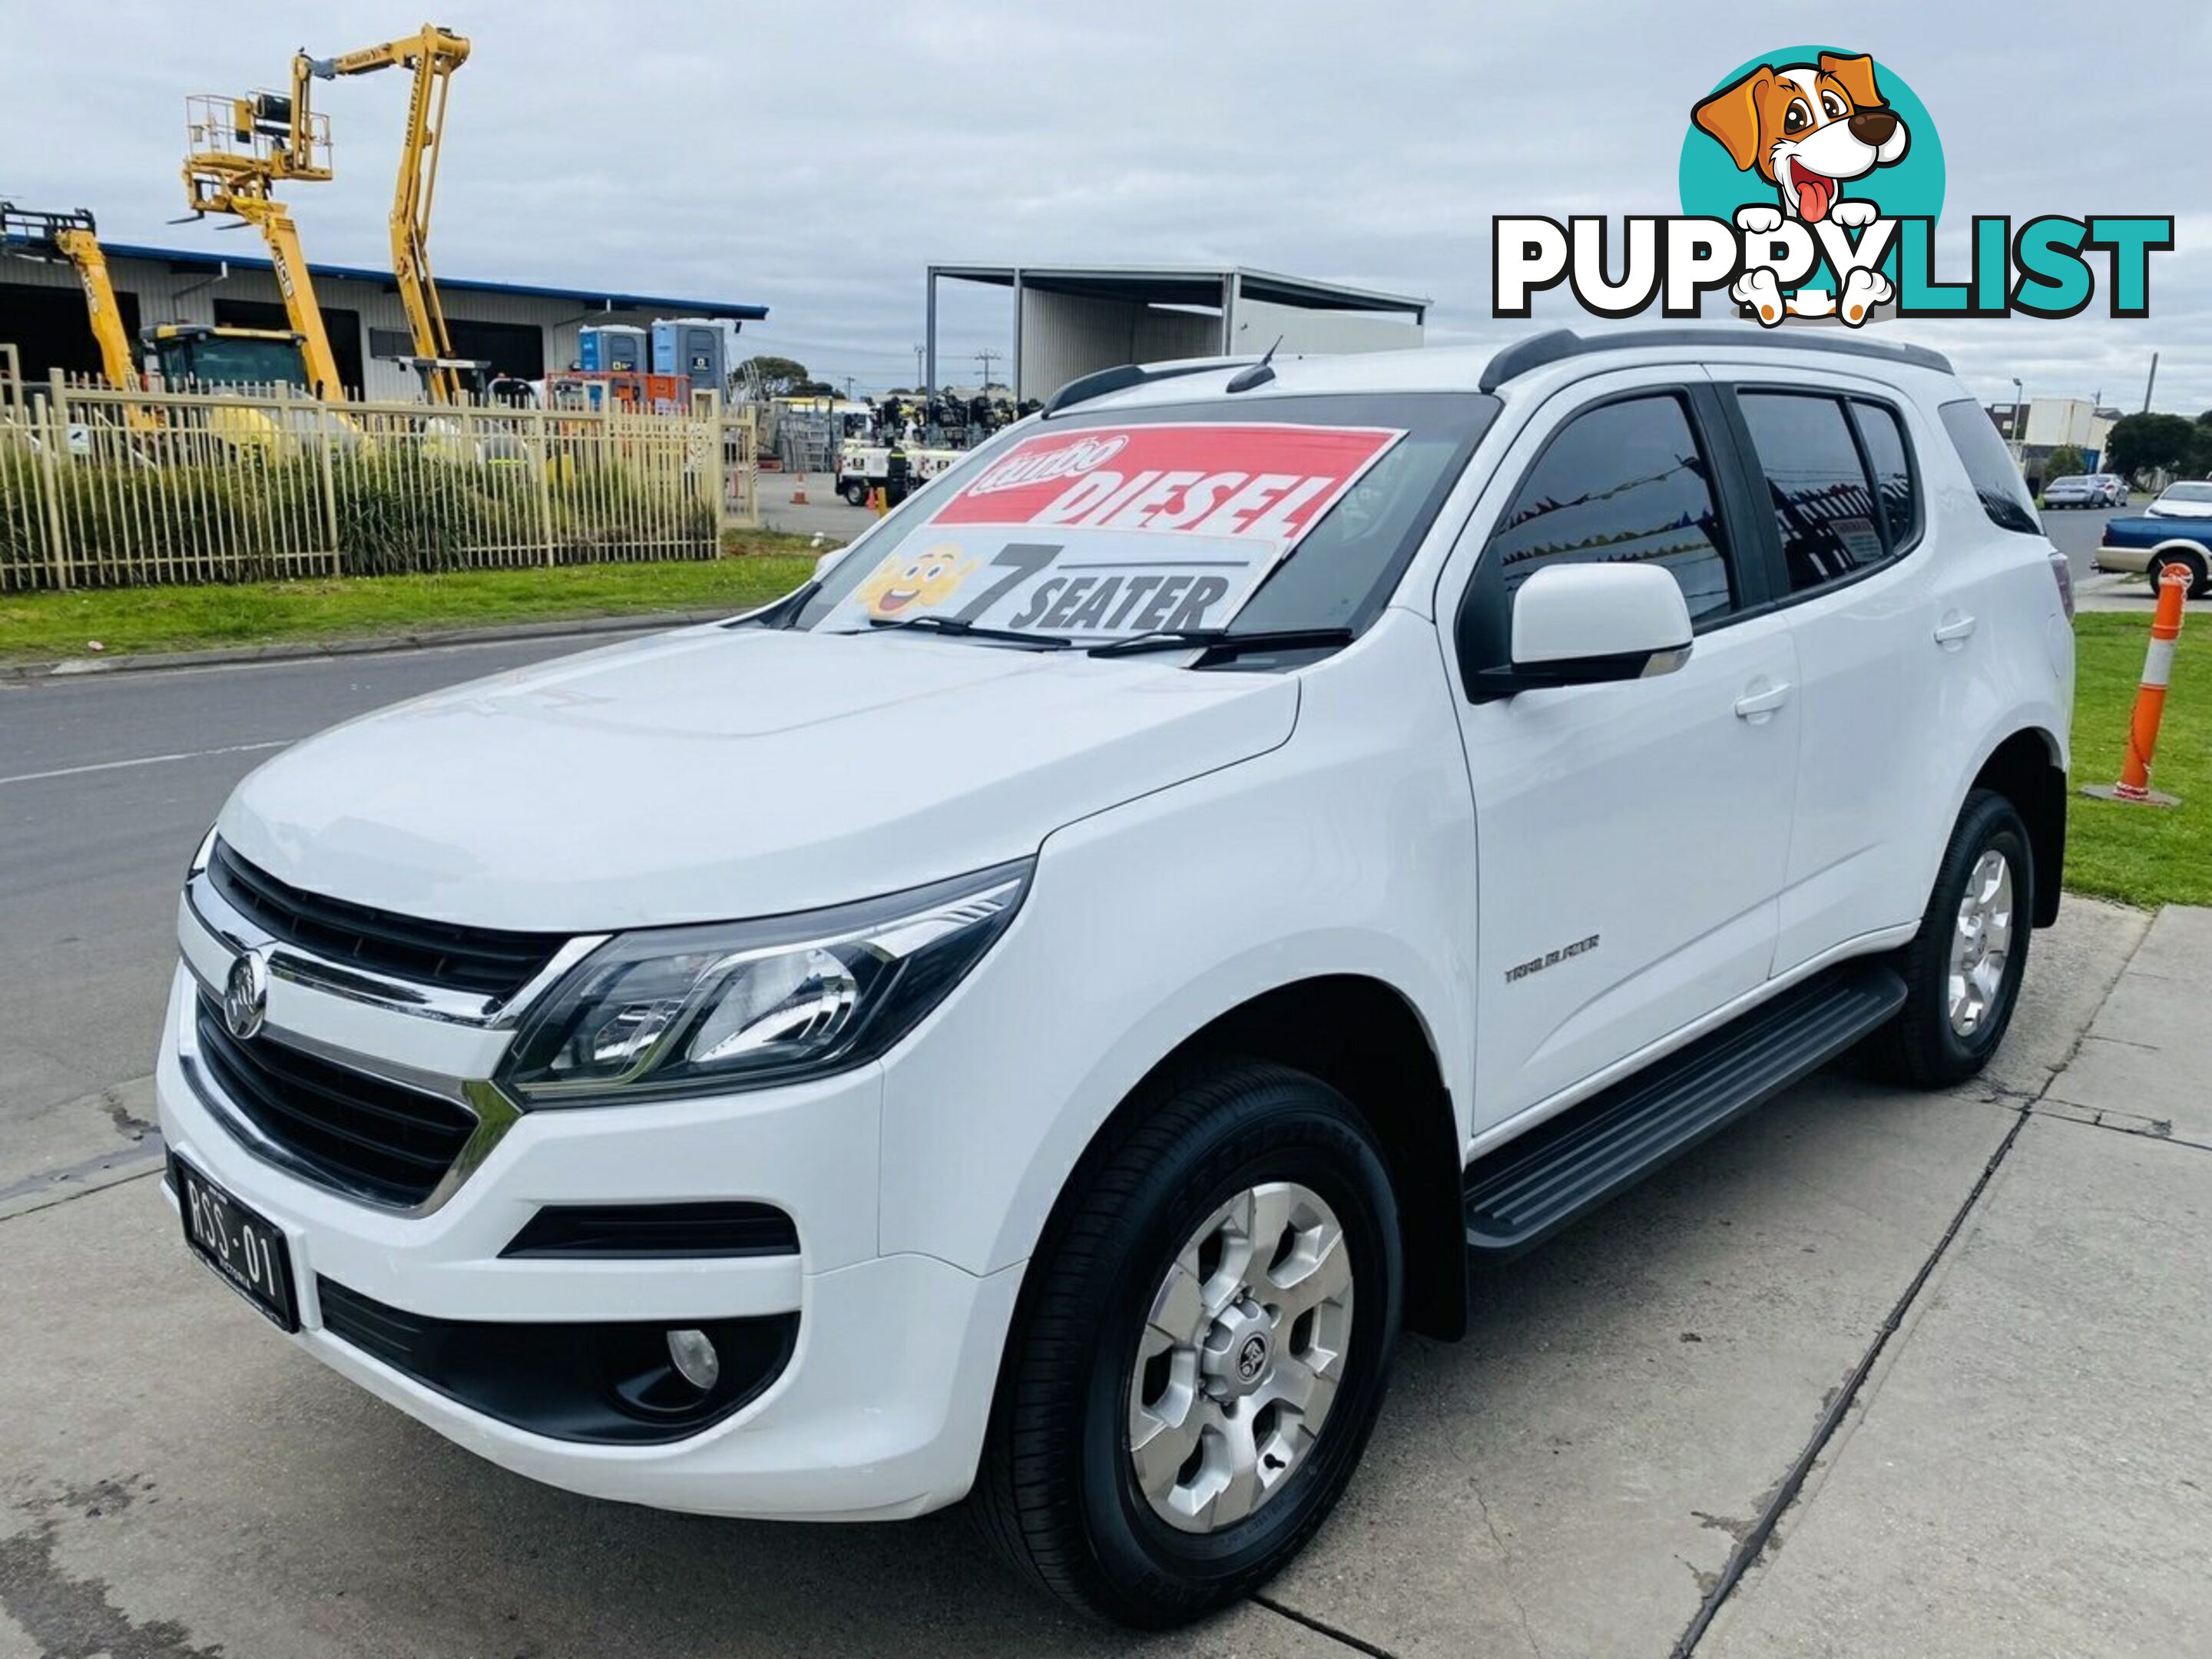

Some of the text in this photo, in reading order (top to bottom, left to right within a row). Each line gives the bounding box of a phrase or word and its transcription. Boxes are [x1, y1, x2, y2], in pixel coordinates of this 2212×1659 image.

[414, 57, 422, 84] PRO
[1028, 470, 1336, 538] DIESEL
[955, 543, 1230, 631] 7 SEATER
